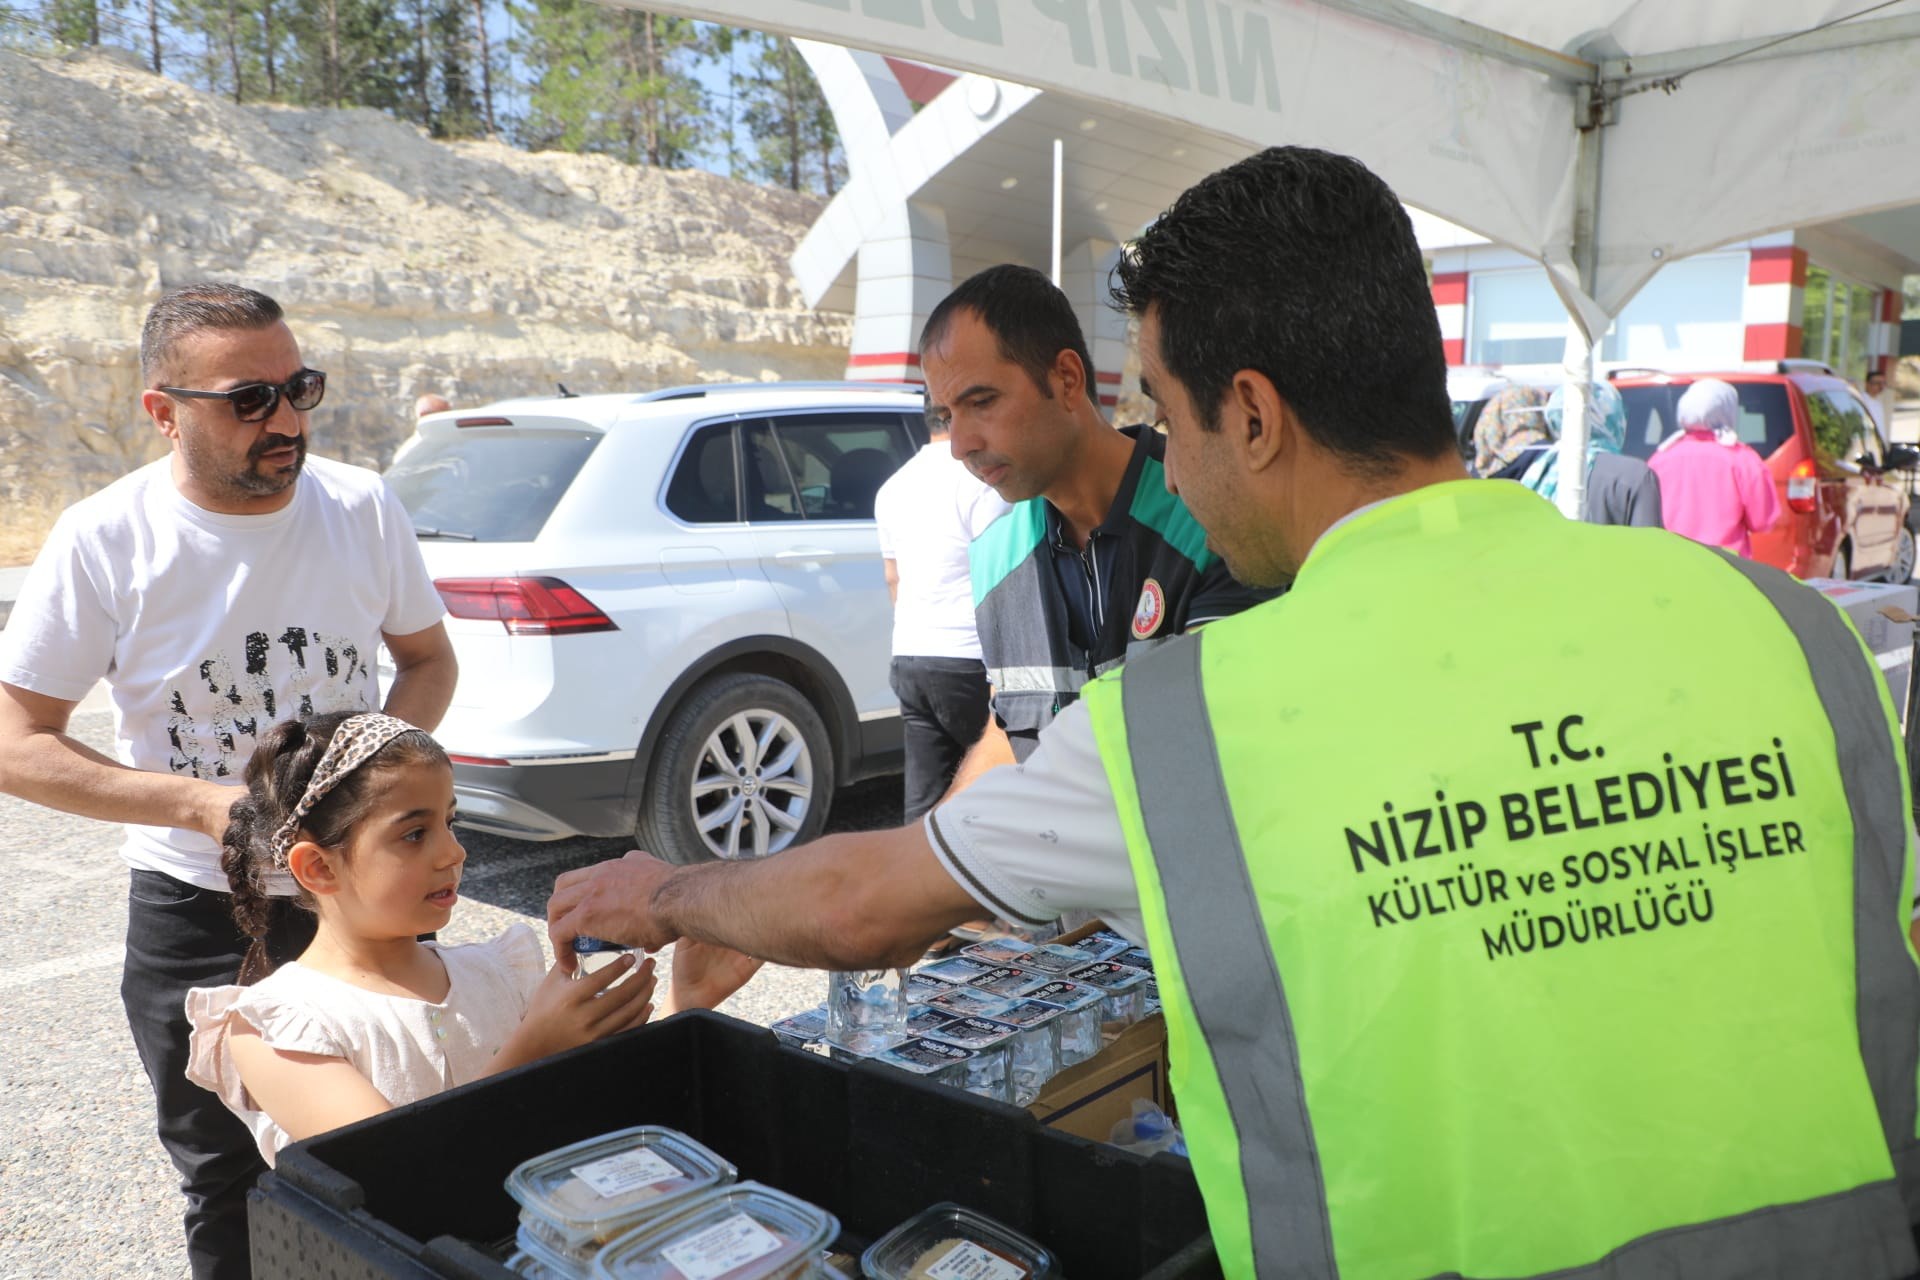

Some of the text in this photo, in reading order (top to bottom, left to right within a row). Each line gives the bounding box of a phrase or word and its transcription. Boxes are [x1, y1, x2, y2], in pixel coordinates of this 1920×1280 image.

[1510, 714, 1605, 769] T.C.
[1344, 737, 1797, 874] NİZİP BELEDİYESİ
[1367, 820, 1807, 928] KÜLTÜR ve SOSYAL İŞLER
[1481, 878, 1715, 961] MÜDÜRLÜĞÜ
